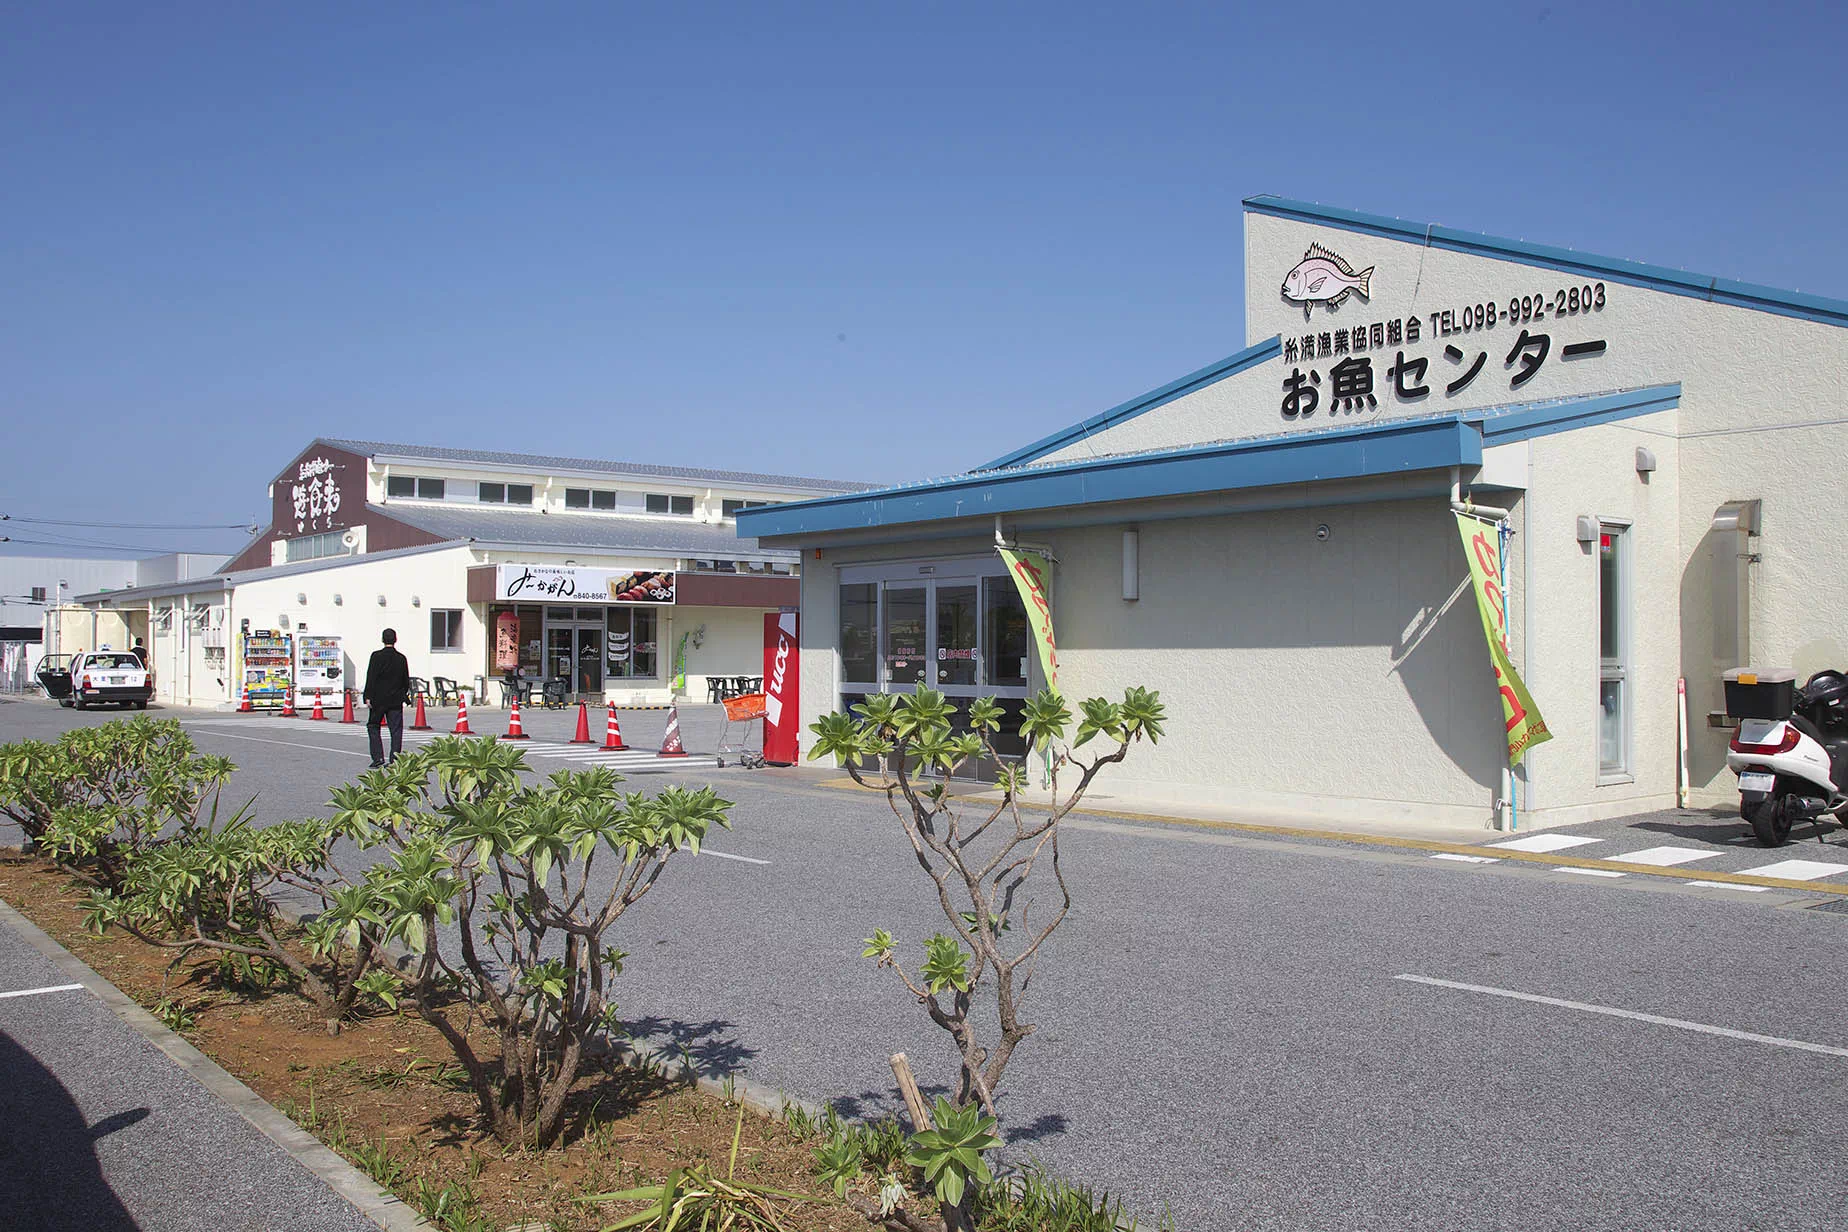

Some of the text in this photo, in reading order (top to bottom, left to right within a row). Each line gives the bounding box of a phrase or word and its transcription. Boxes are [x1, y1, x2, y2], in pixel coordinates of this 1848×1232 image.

[1281, 329, 1607, 417] お魚センター
[1284, 315, 1422, 364] 糸満漁業協同組合
